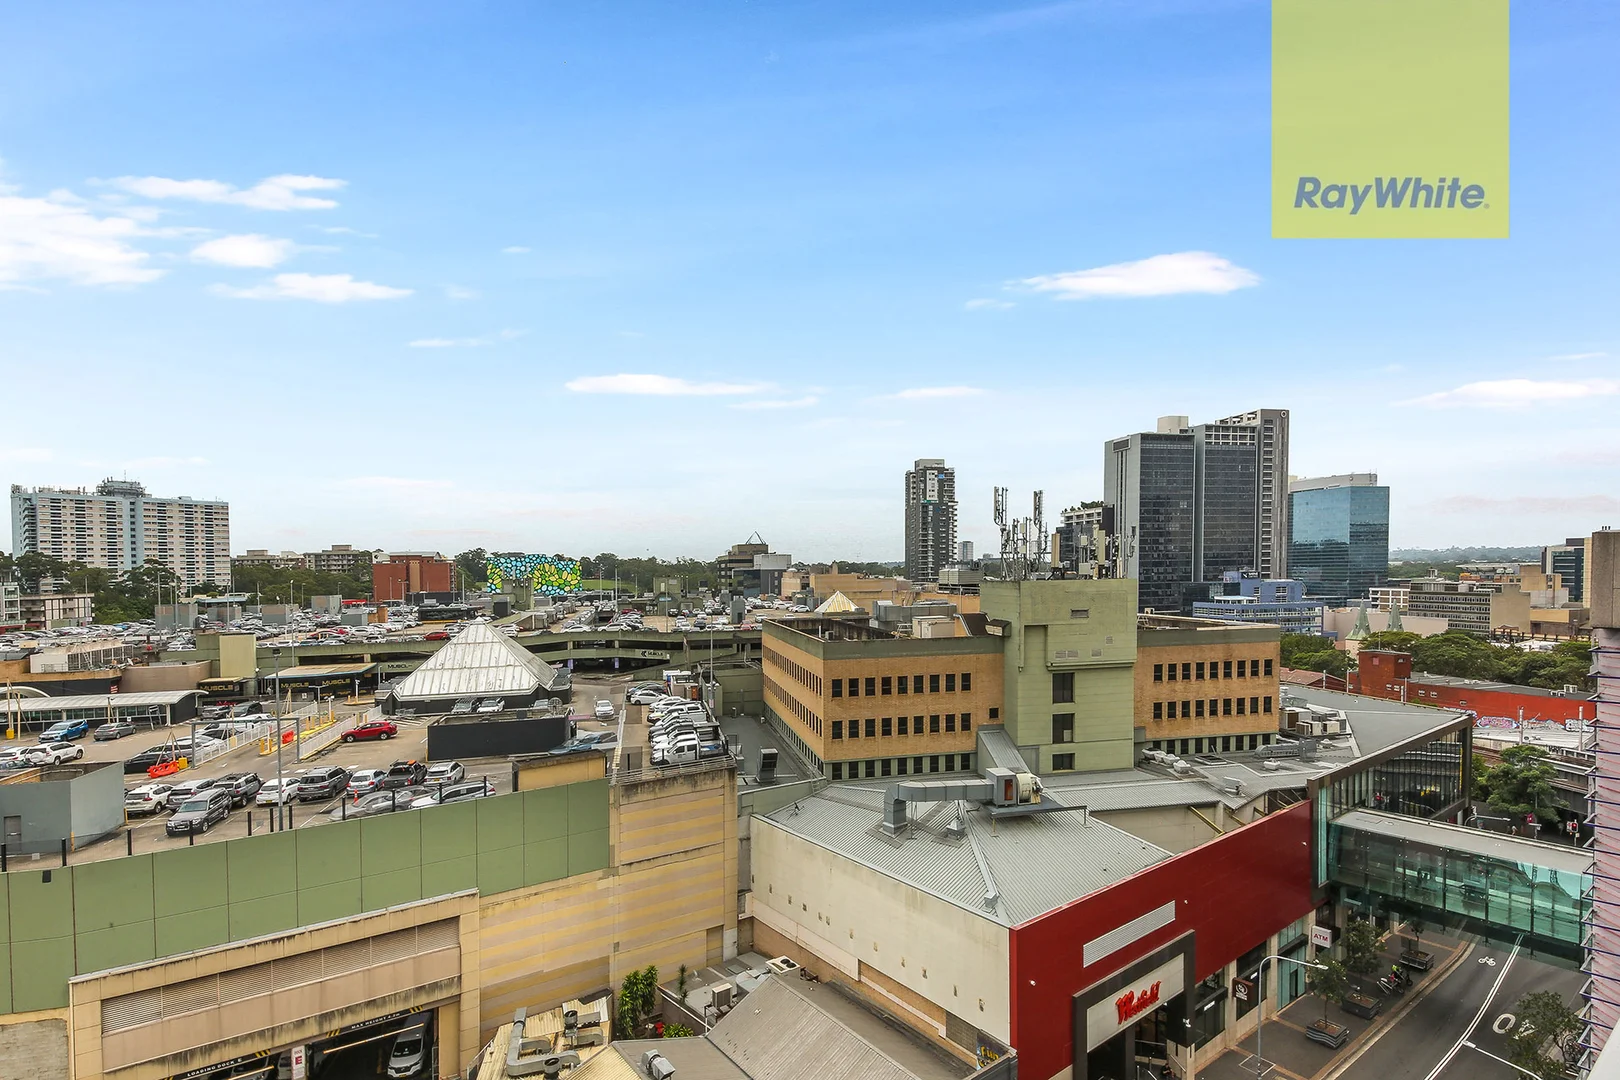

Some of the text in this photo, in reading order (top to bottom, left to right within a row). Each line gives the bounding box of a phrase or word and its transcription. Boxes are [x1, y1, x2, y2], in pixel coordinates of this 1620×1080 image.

[1313, 933, 1329, 942] ATM
[1115, 980, 1161, 1025] Westfield
[295, 1055, 302, 1066] E
[187, 1066, 216, 1077] LOADING
[217, 1060, 235, 1069] DOCK
